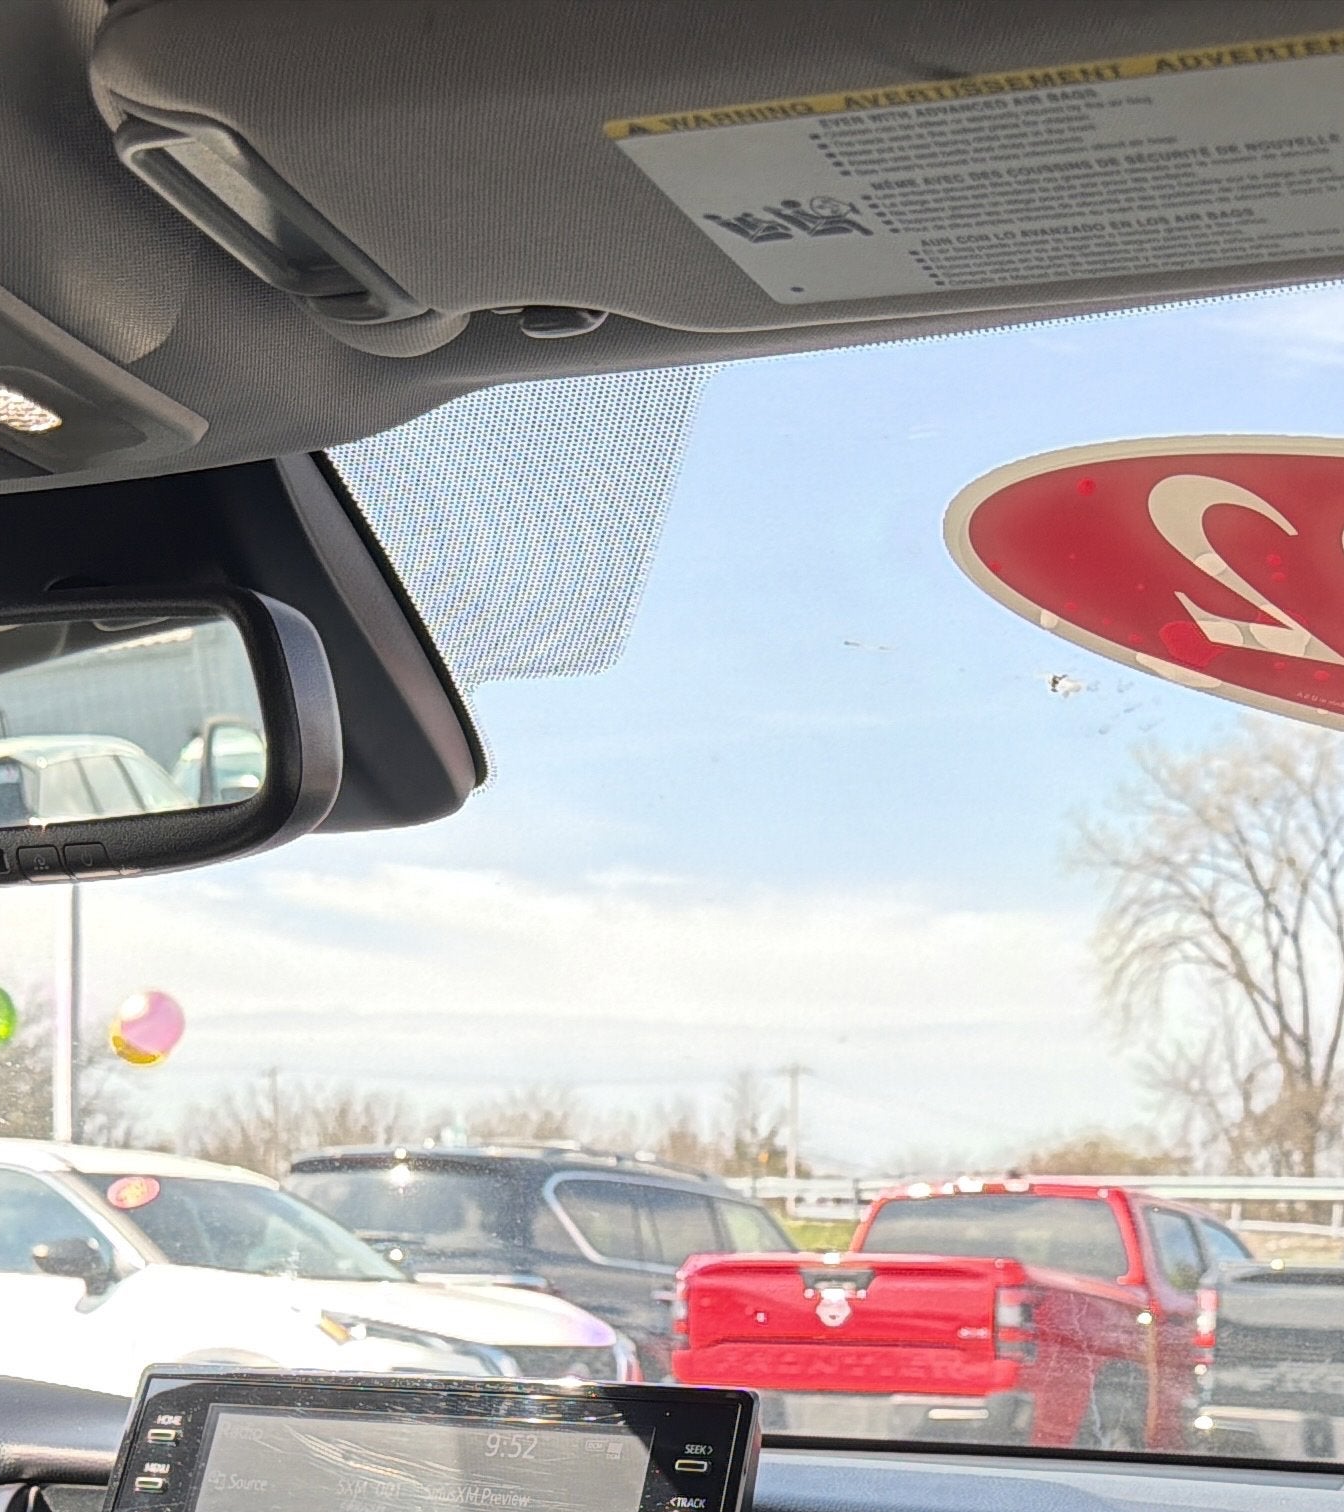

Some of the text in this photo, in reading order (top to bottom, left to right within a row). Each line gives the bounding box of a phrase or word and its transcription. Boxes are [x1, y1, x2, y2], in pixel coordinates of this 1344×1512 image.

[665, 102, 813, 131] WARNING
[844, 66, 1122, 110] AVERTISSEMENT
[867, 110, 913, 122] WITH
[915, 99, 1008, 117] ADVANCED
[1013, 94, 1041, 106] AIR
[1046, 88, 1097, 102] BAGS
[1096, 156, 1117, 169] DE
[1215, 144, 1239, 158] DE
[1019, 221, 1105, 240] AVANZADO
[1174, 210, 1212, 225] AIR
[156, 1414, 182, 1426] HOME
[483, 1433, 538, 1460] 9:52
[684, 1443, 706, 1455] SEEK
[144, 1461, 170, 1474] MENU
[230, 1475, 268, 1491] Source
[482, 1487, 532, 1509] Preview
[676, 1497, 706, 1509] TRACK
